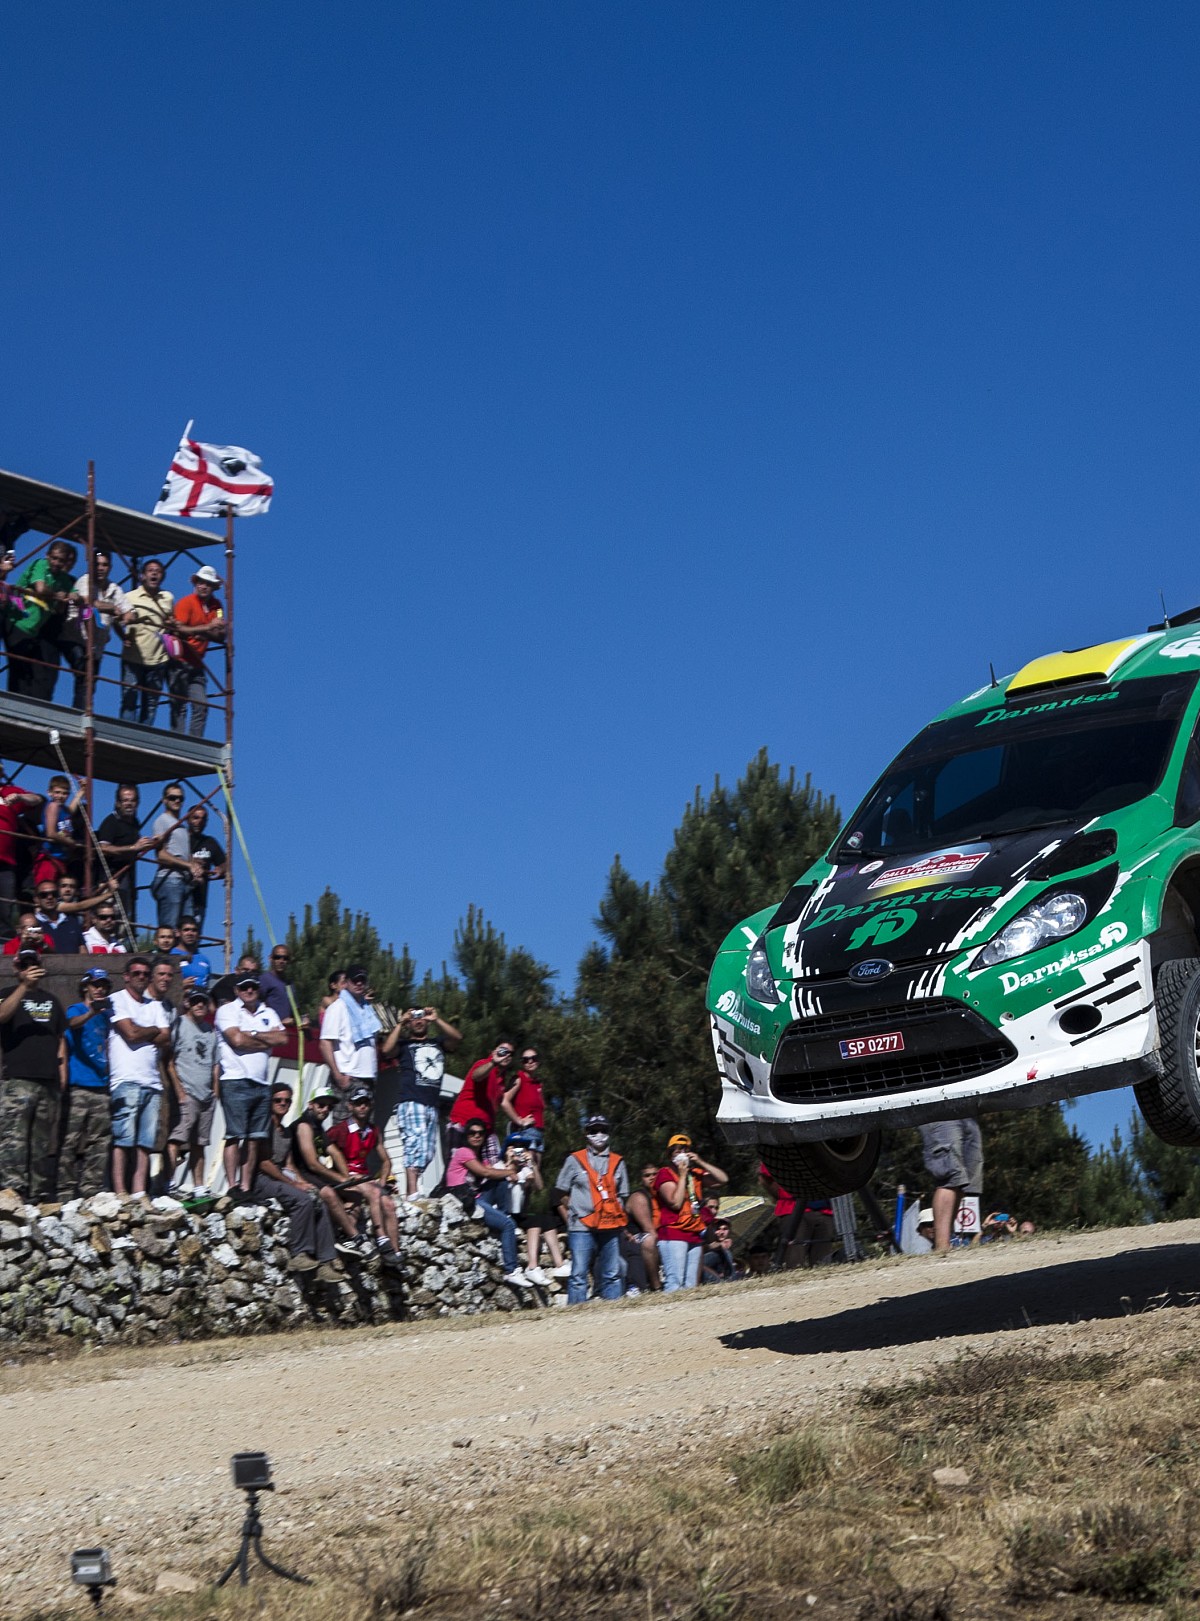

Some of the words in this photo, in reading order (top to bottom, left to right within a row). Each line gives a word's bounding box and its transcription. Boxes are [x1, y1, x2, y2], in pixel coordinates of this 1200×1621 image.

[975, 690, 1120, 727] Darnitsa
[880, 868, 912, 880] RALLY
[938, 857, 980, 868] Sardegna
[803, 885, 1003, 931] Darnitsa
[857, 962, 882, 977] Ford
[998, 943, 1104, 995] Darnitsa
[726, 999, 761, 1035] Darnitsa
[848, 1041, 866, 1055] SP
[867, 1035, 898, 1052] 0277
